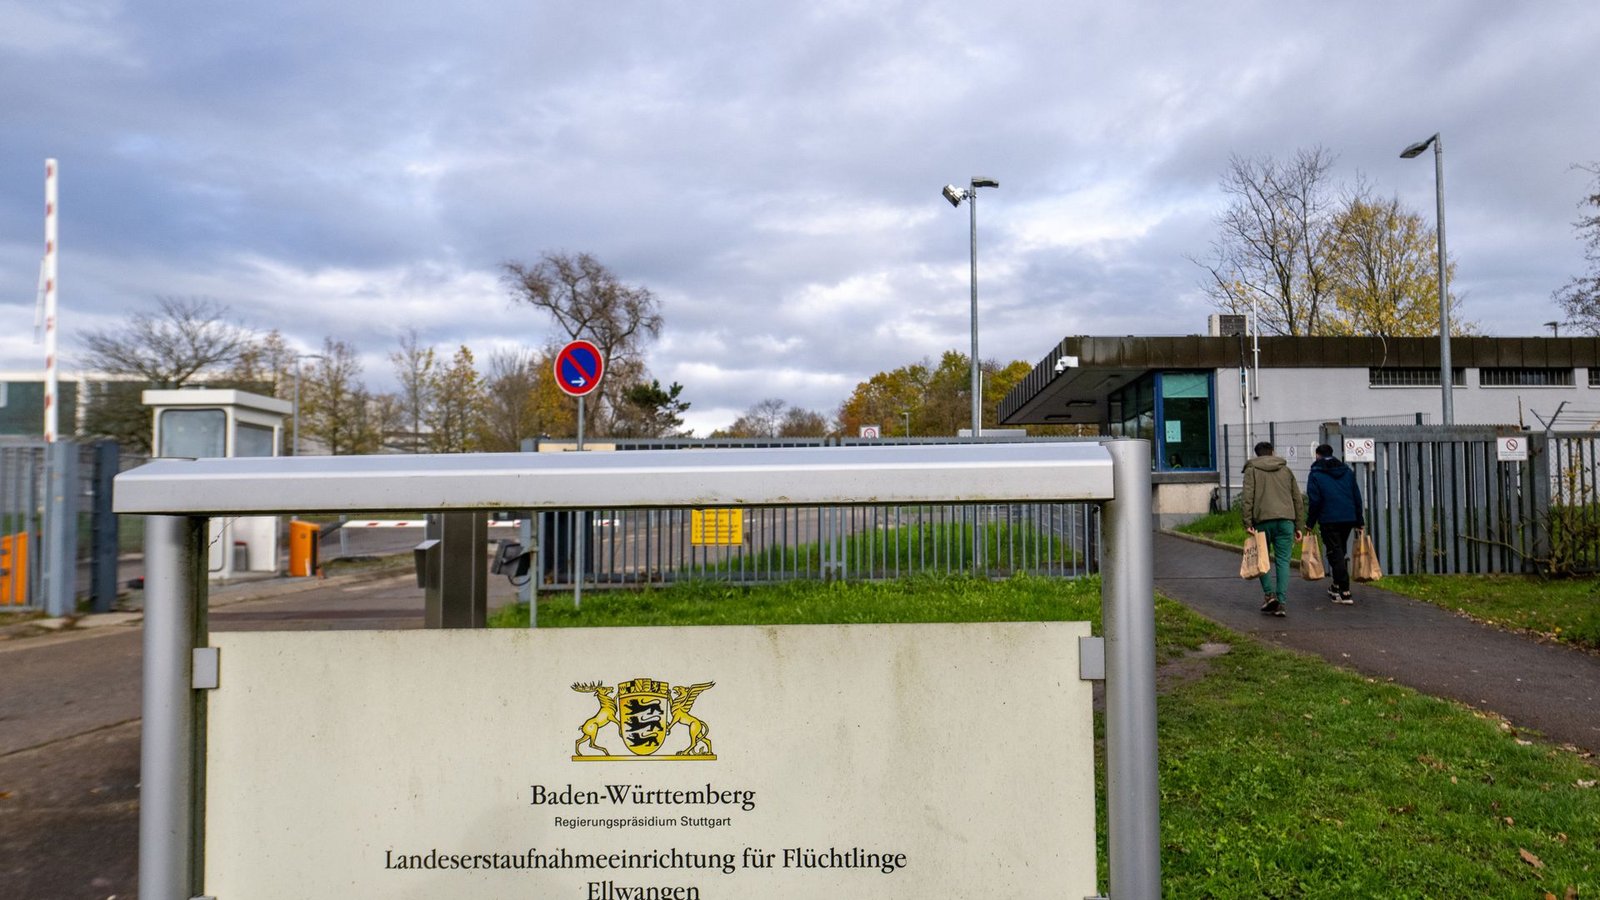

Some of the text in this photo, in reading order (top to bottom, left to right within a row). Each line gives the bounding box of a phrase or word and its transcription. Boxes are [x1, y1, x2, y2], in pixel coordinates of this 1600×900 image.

[531, 784, 756, 811] Baden-Württemberg
[554, 816, 731, 829] Regierungspräsidium Stuttgart
[385, 848, 907, 875] Landeserstaufnahmeeinrichtung für Flüchtlinge
